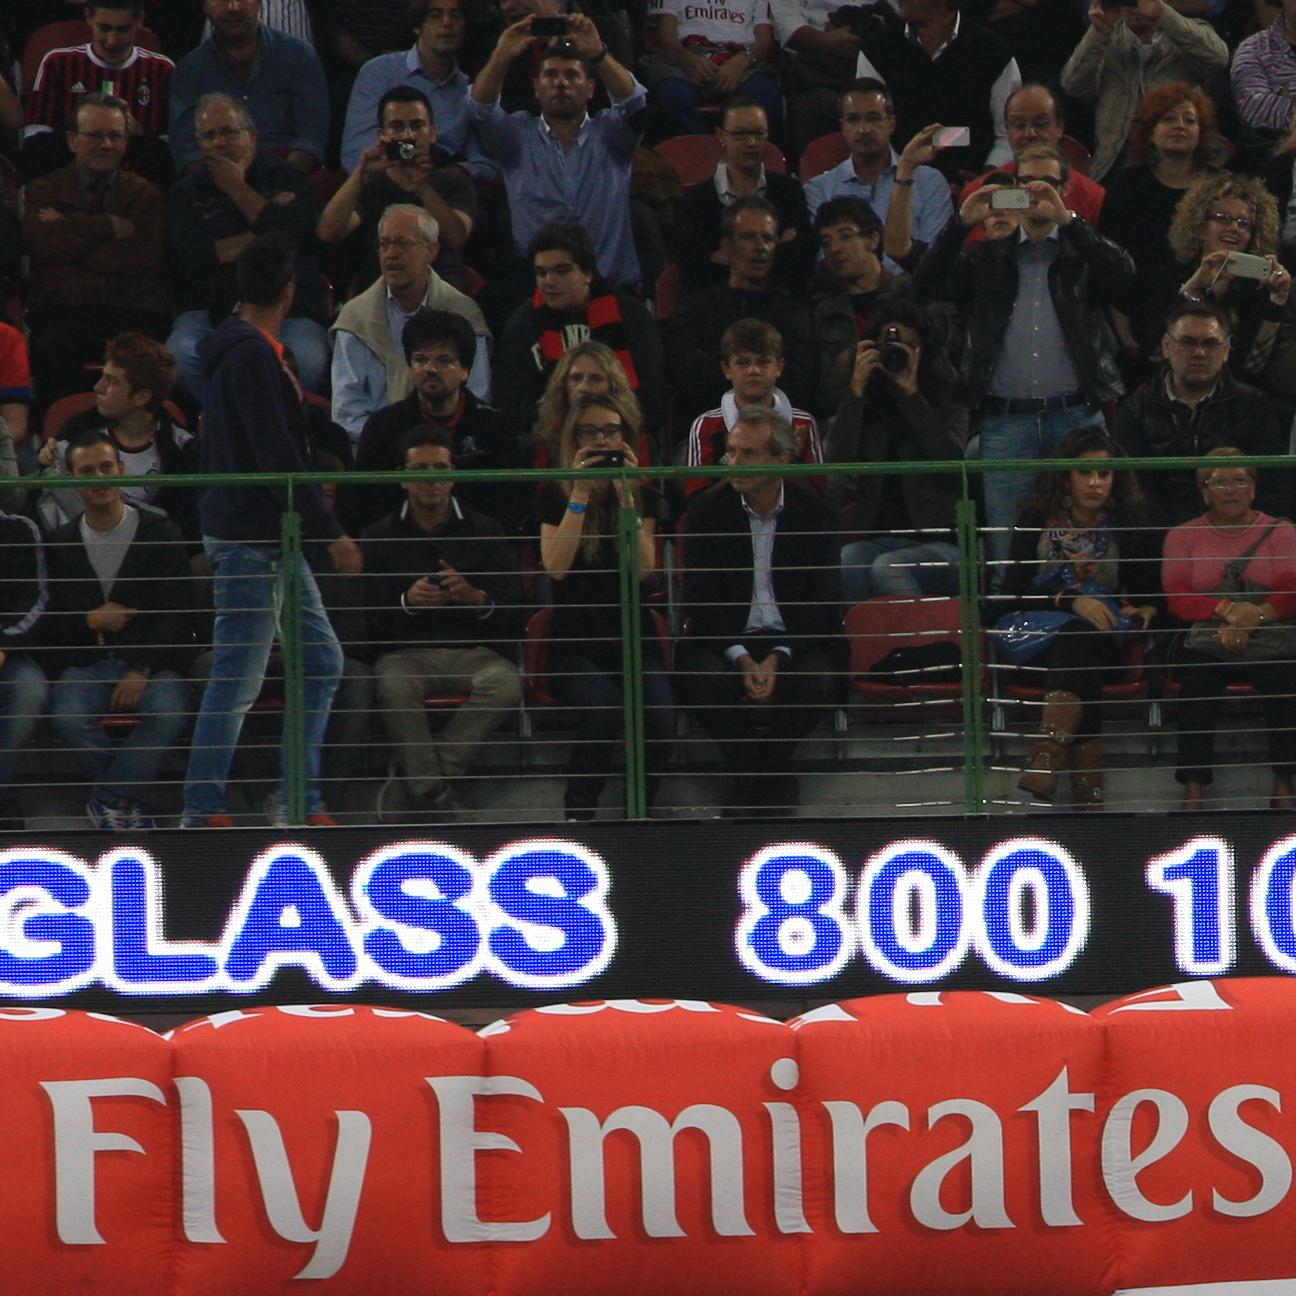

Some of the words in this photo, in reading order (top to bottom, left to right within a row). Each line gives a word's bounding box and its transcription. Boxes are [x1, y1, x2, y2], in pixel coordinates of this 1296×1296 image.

[0, 838, 618, 997] GLASS
[737, 836, 1091, 986] 800
[39, 1077, 373, 1280] Fly
[425, 1057, 1293, 1244] Emirates
